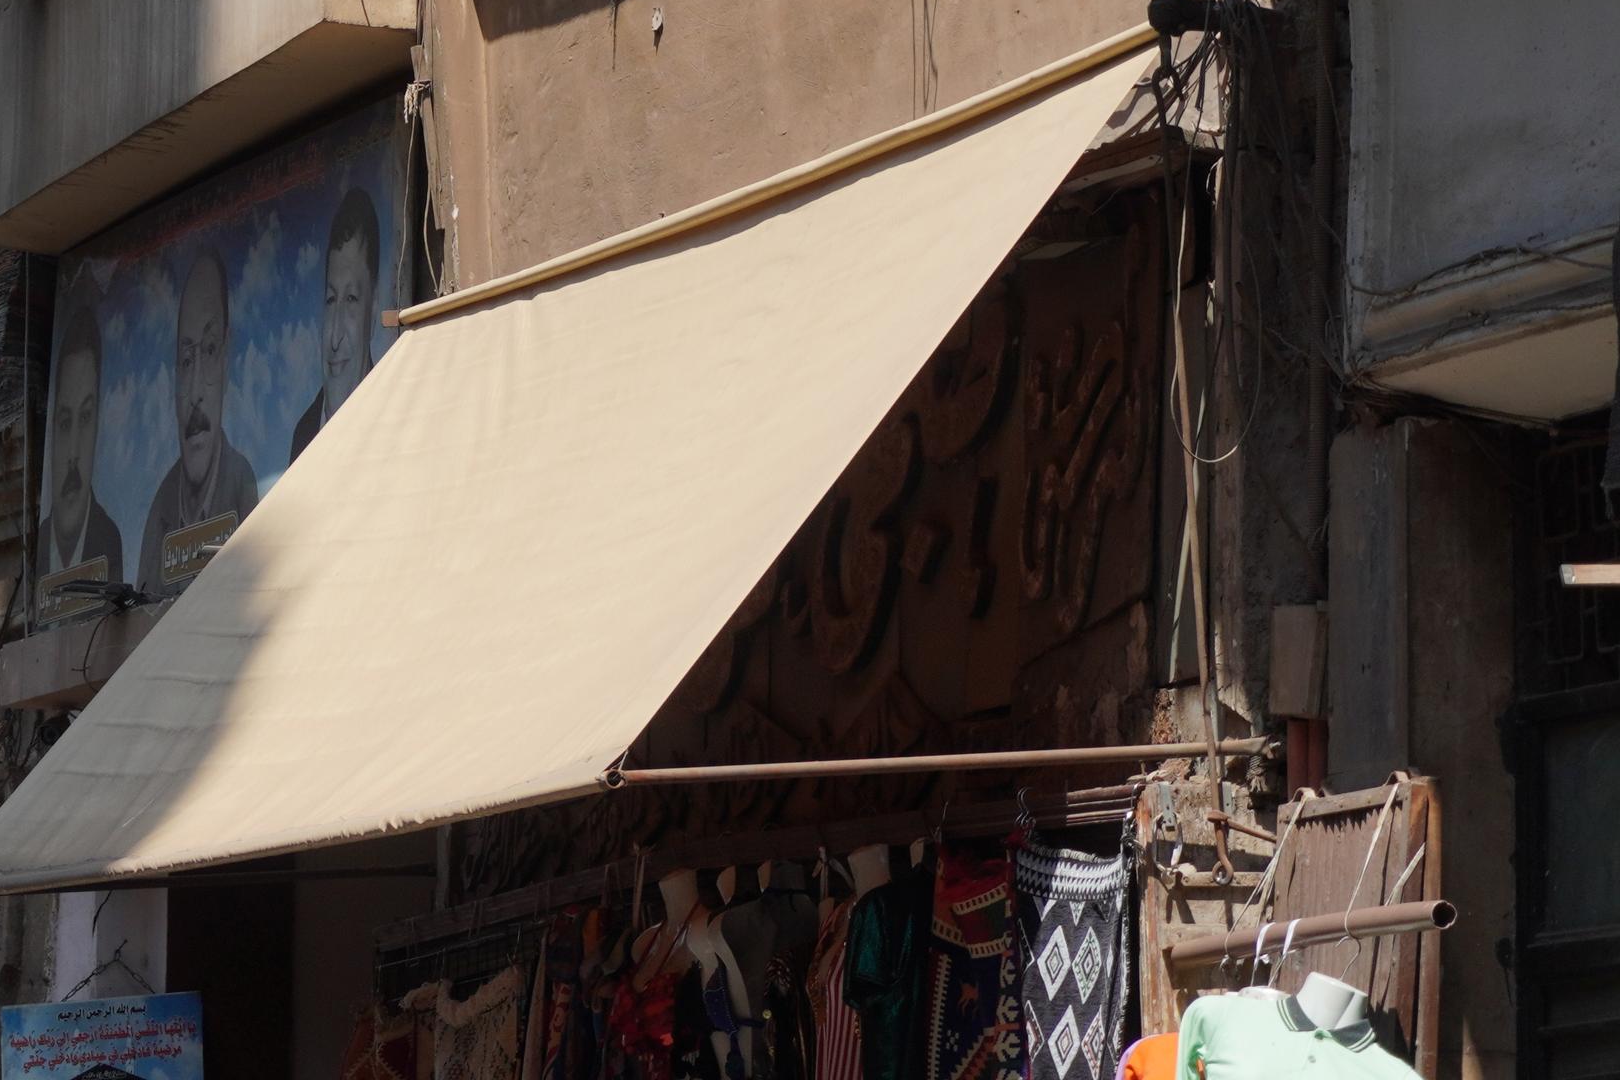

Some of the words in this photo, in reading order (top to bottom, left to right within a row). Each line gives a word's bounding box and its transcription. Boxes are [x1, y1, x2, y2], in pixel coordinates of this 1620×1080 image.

[86, 1006, 115, 1020] الرحمن
[116, 1003, 129, 1014] الله
[130, 1004, 147, 1016] بسم
[58, 1009, 84, 1021] الرحيم
